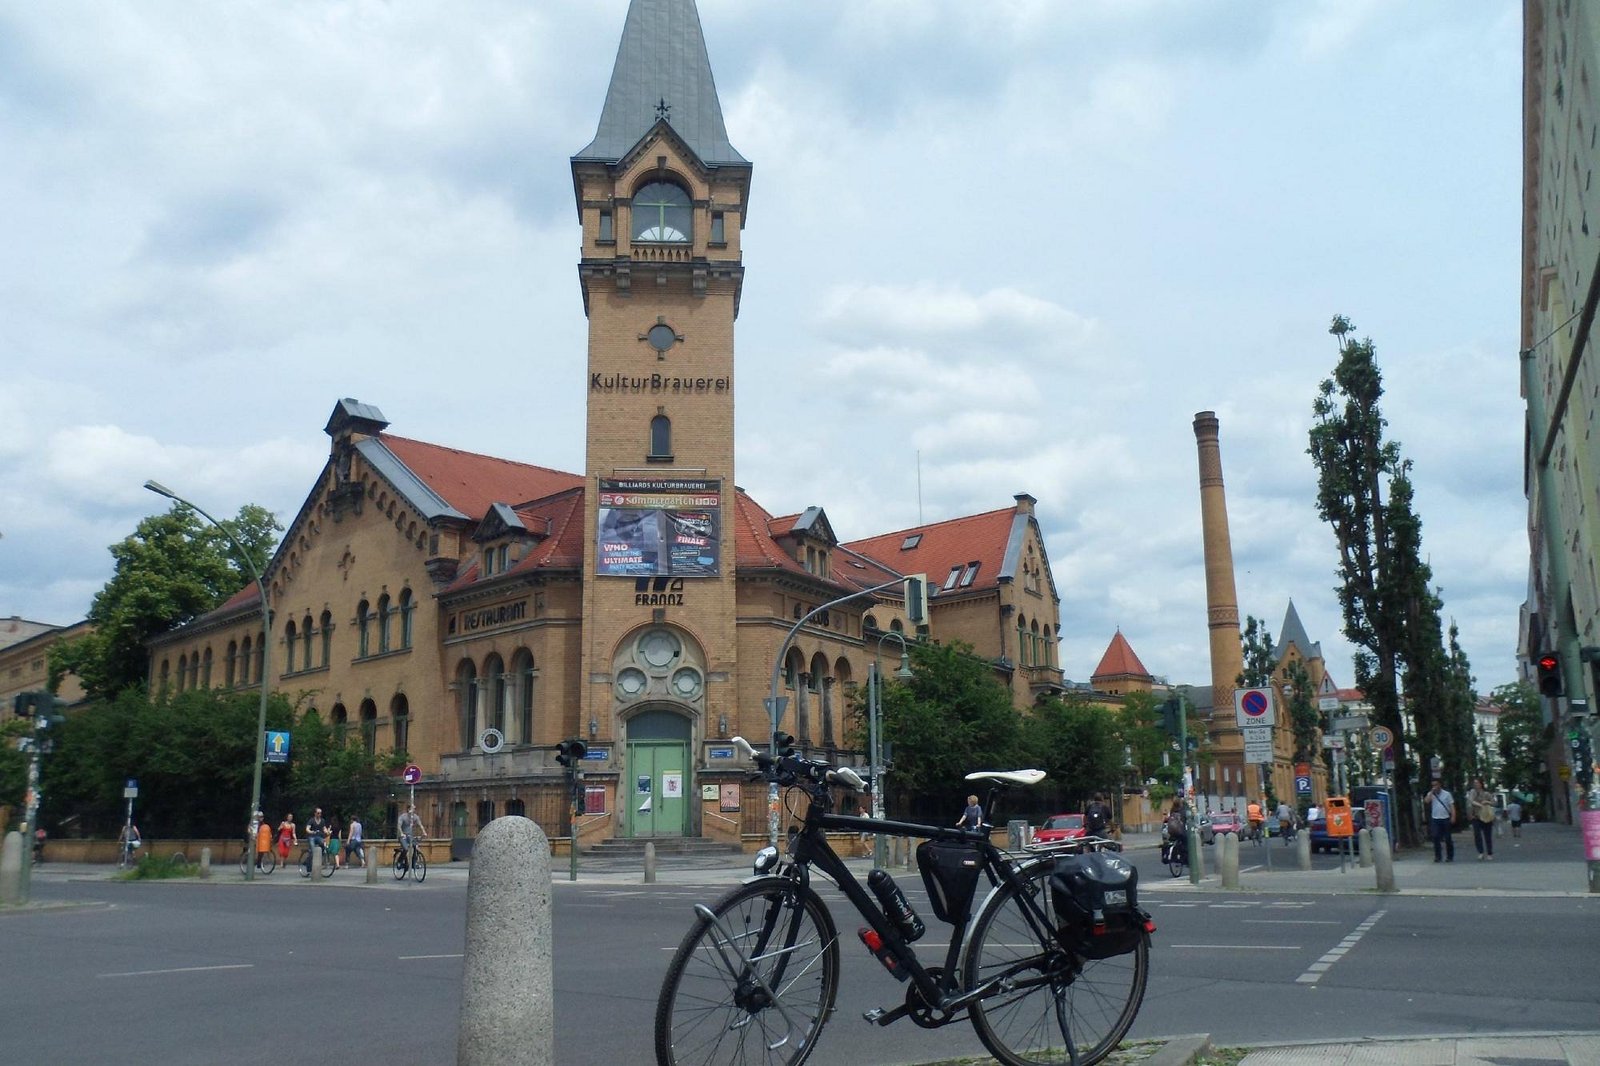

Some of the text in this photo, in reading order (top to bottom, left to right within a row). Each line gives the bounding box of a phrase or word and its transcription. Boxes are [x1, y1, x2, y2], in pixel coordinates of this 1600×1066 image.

[591, 373, 730, 390] KulturBrauerei
[678, 536, 705, 545] FINALE
[1374, 732, 1388, 742] 30
